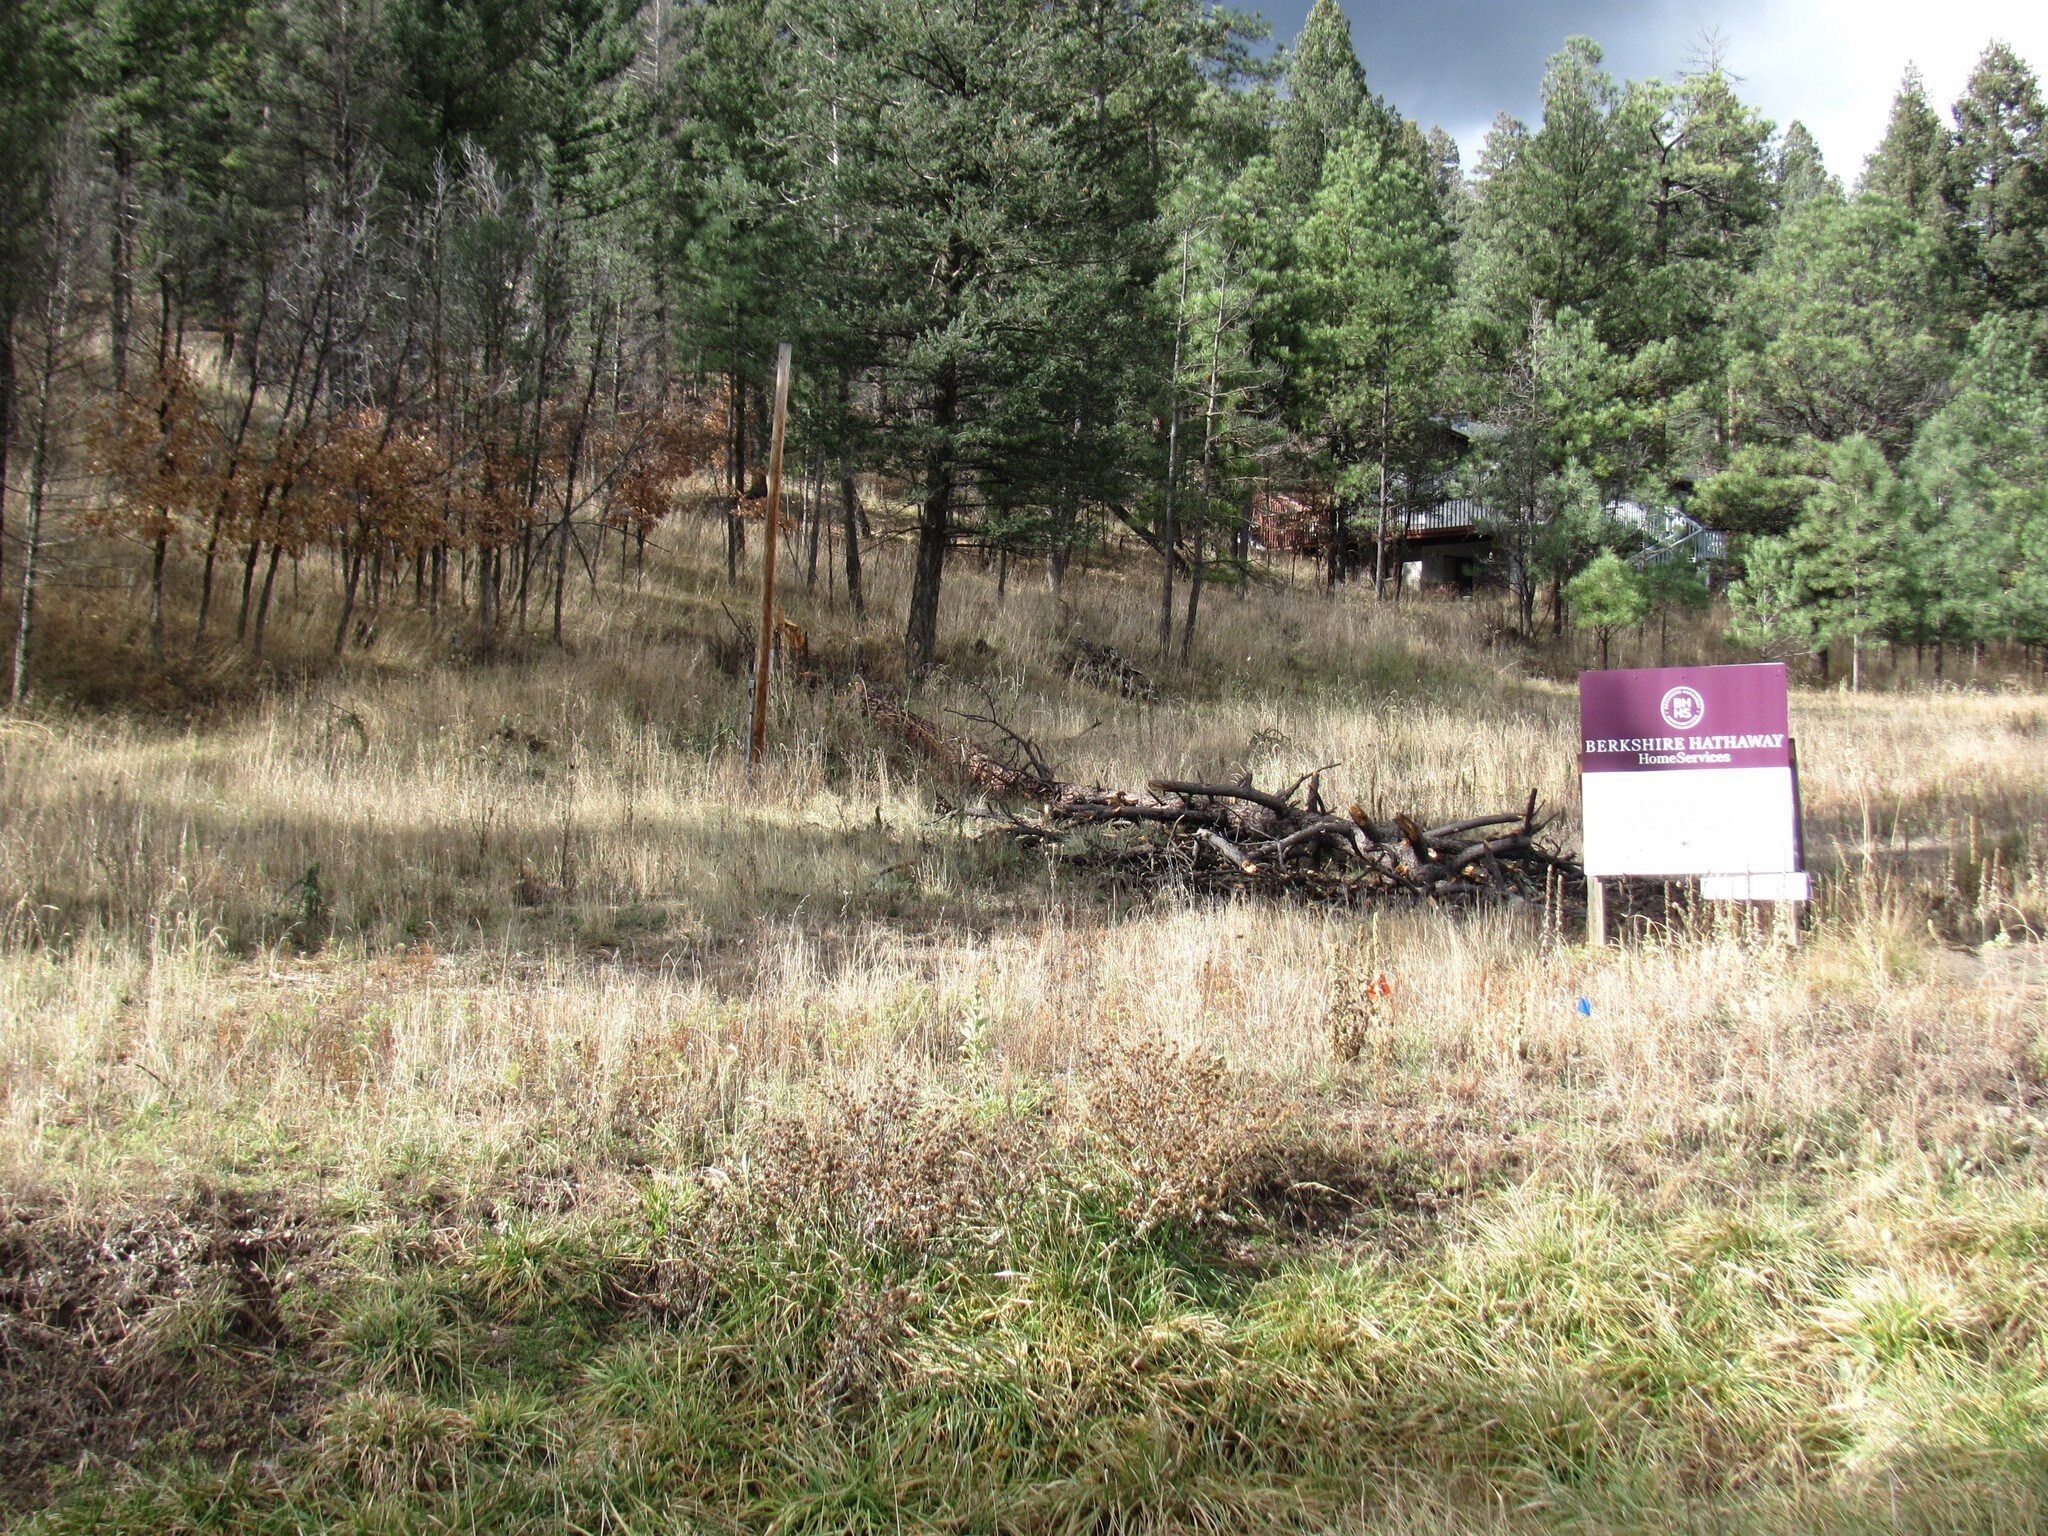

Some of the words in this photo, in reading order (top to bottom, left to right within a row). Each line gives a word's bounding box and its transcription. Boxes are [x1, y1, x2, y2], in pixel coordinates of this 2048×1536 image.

[1673, 697, 1692, 708] BH
[1673, 707, 1692, 719] HS
[1585, 737, 1685, 753] BERKSHIRE
[1689, 734, 1785, 751] HATHAWAY
[1638, 751, 1732, 765] HomeServices
